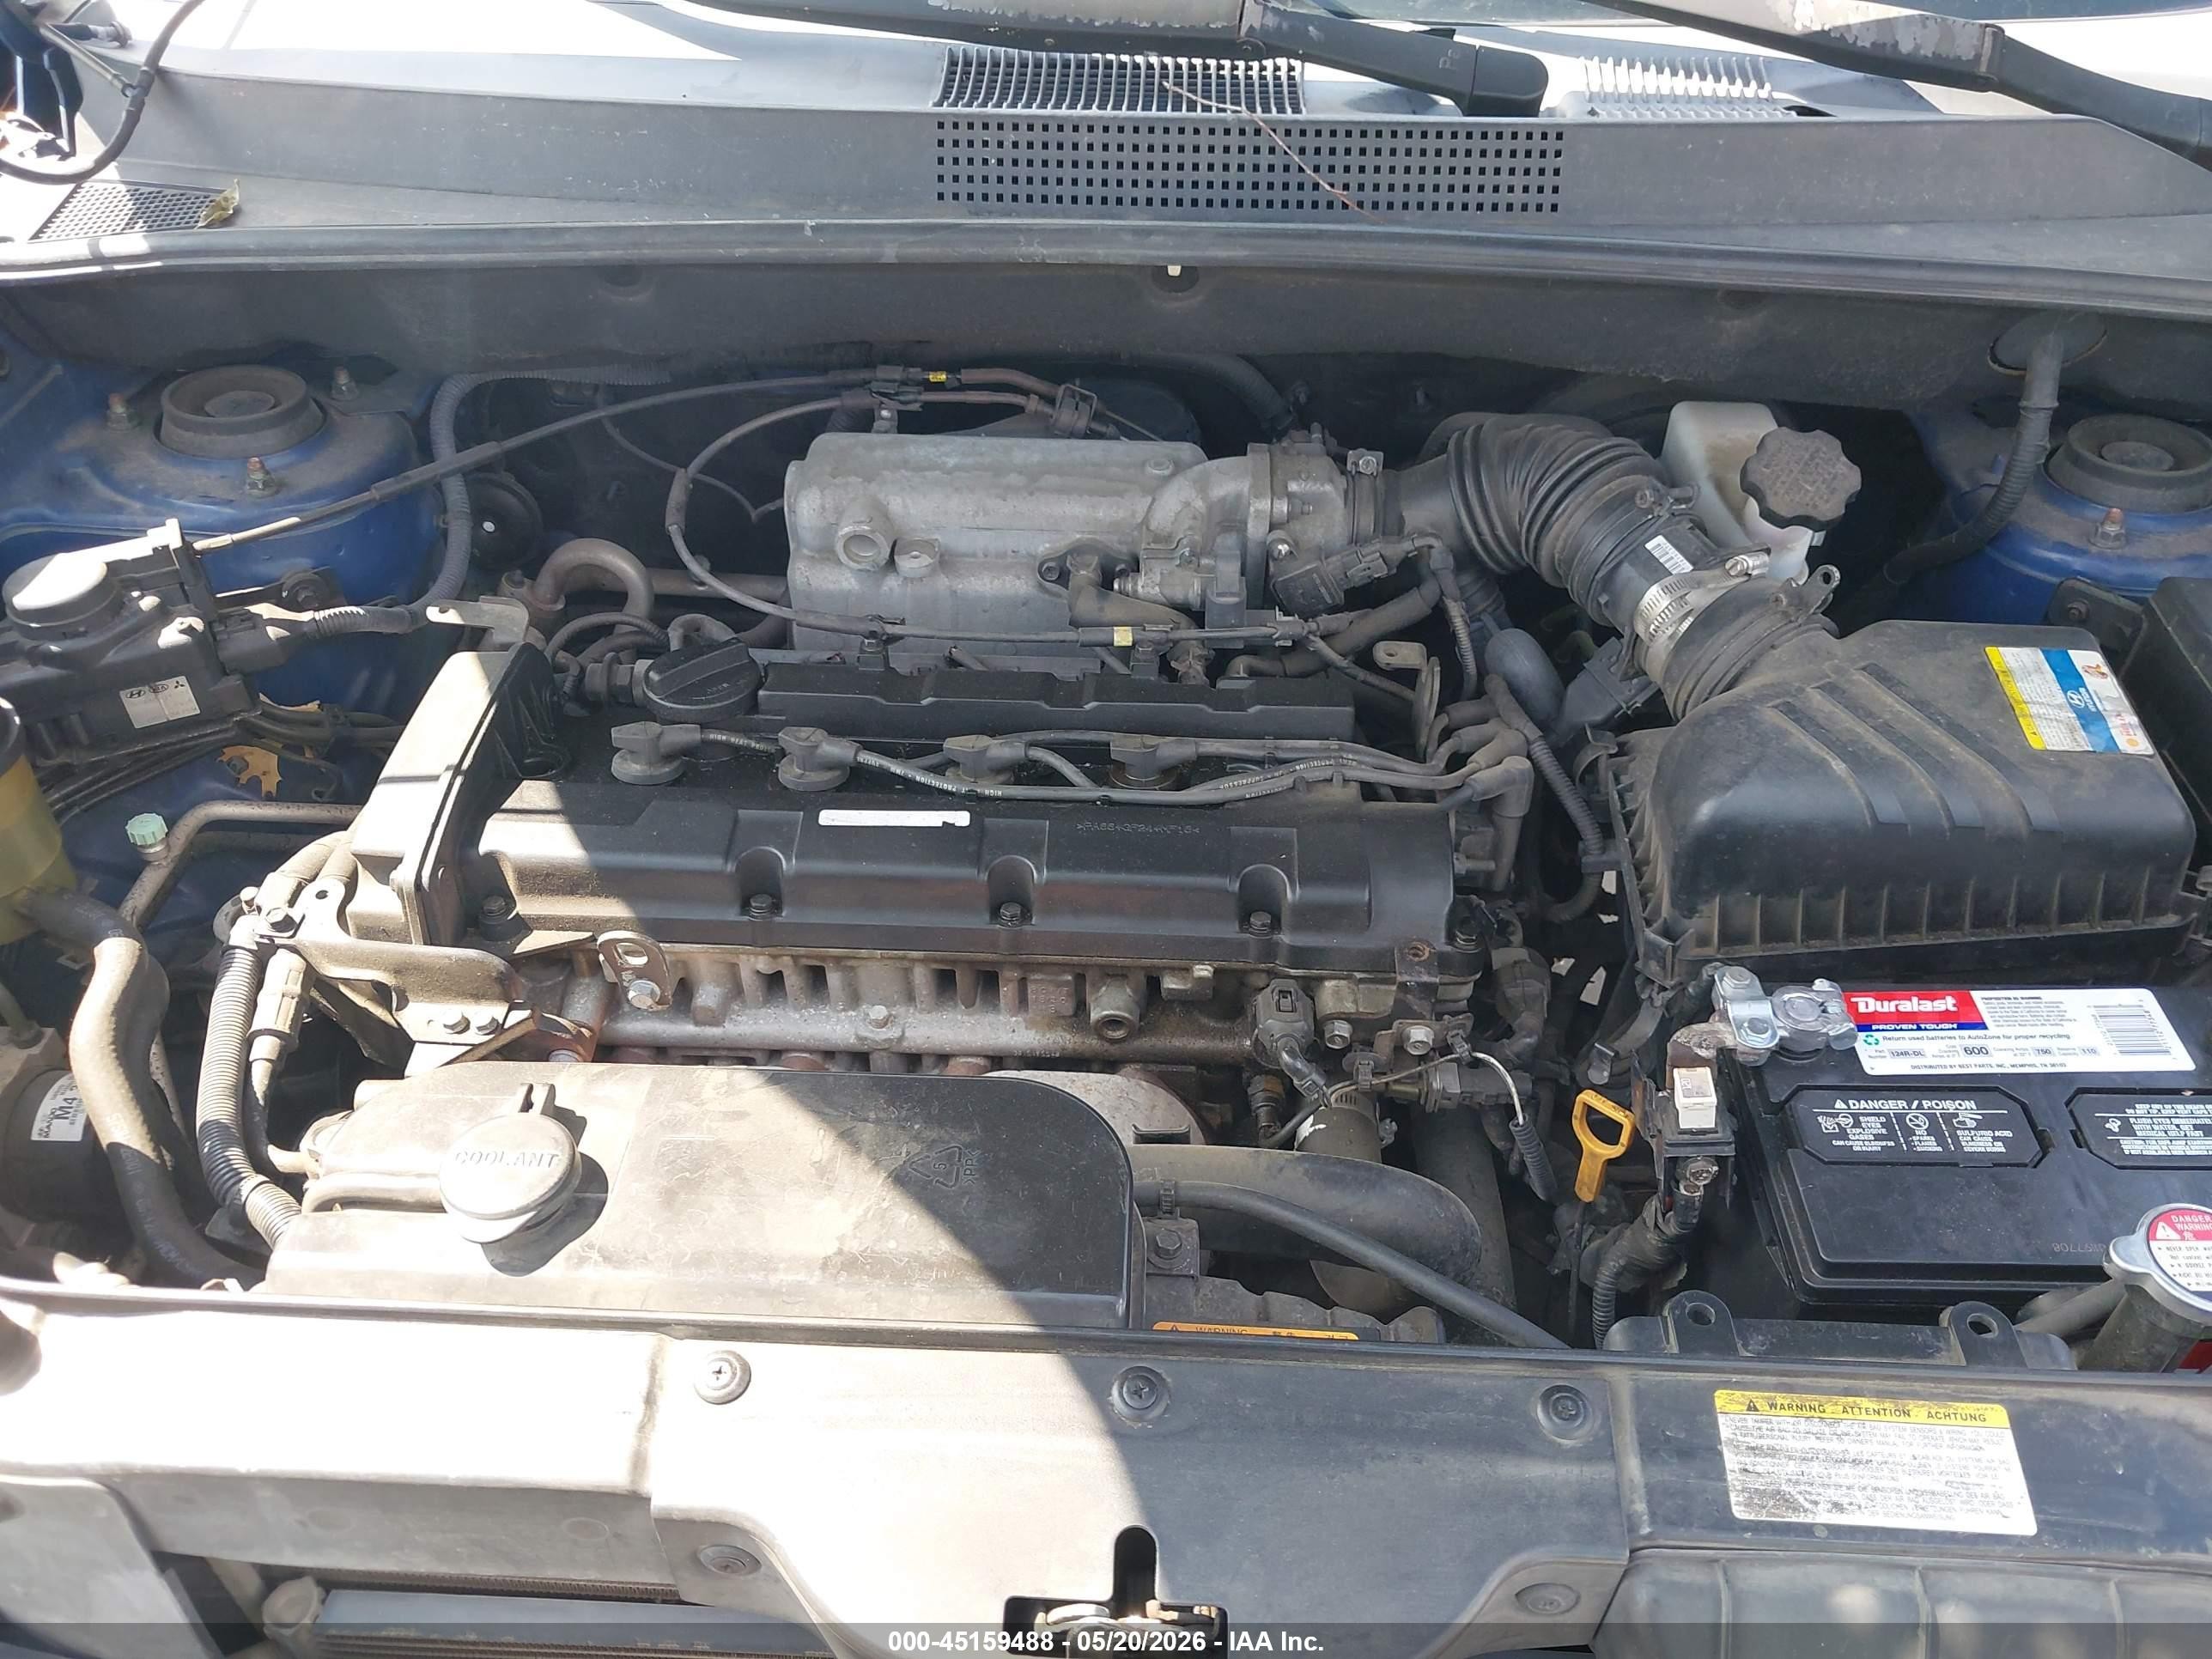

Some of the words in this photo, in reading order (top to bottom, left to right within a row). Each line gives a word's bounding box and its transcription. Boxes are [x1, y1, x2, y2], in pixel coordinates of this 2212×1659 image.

[1850, 996, 1958, 1012] Duralast
[1964, 1046, 1989, 1055] 600
[1848, 1099, 1908, 1109] DANGER
[1922, 1099, 1977, 1109] POISON
[44, 1107, 57, 1139] MANDO
[454, 1151, 560, 1169] COOLANT
[1767, 1401, 1826, 1413] WARNING
[1842, 1406, 1911, 1418] ATTENTION
[1927, 1411, 1986, 1422] ACHTUNG
